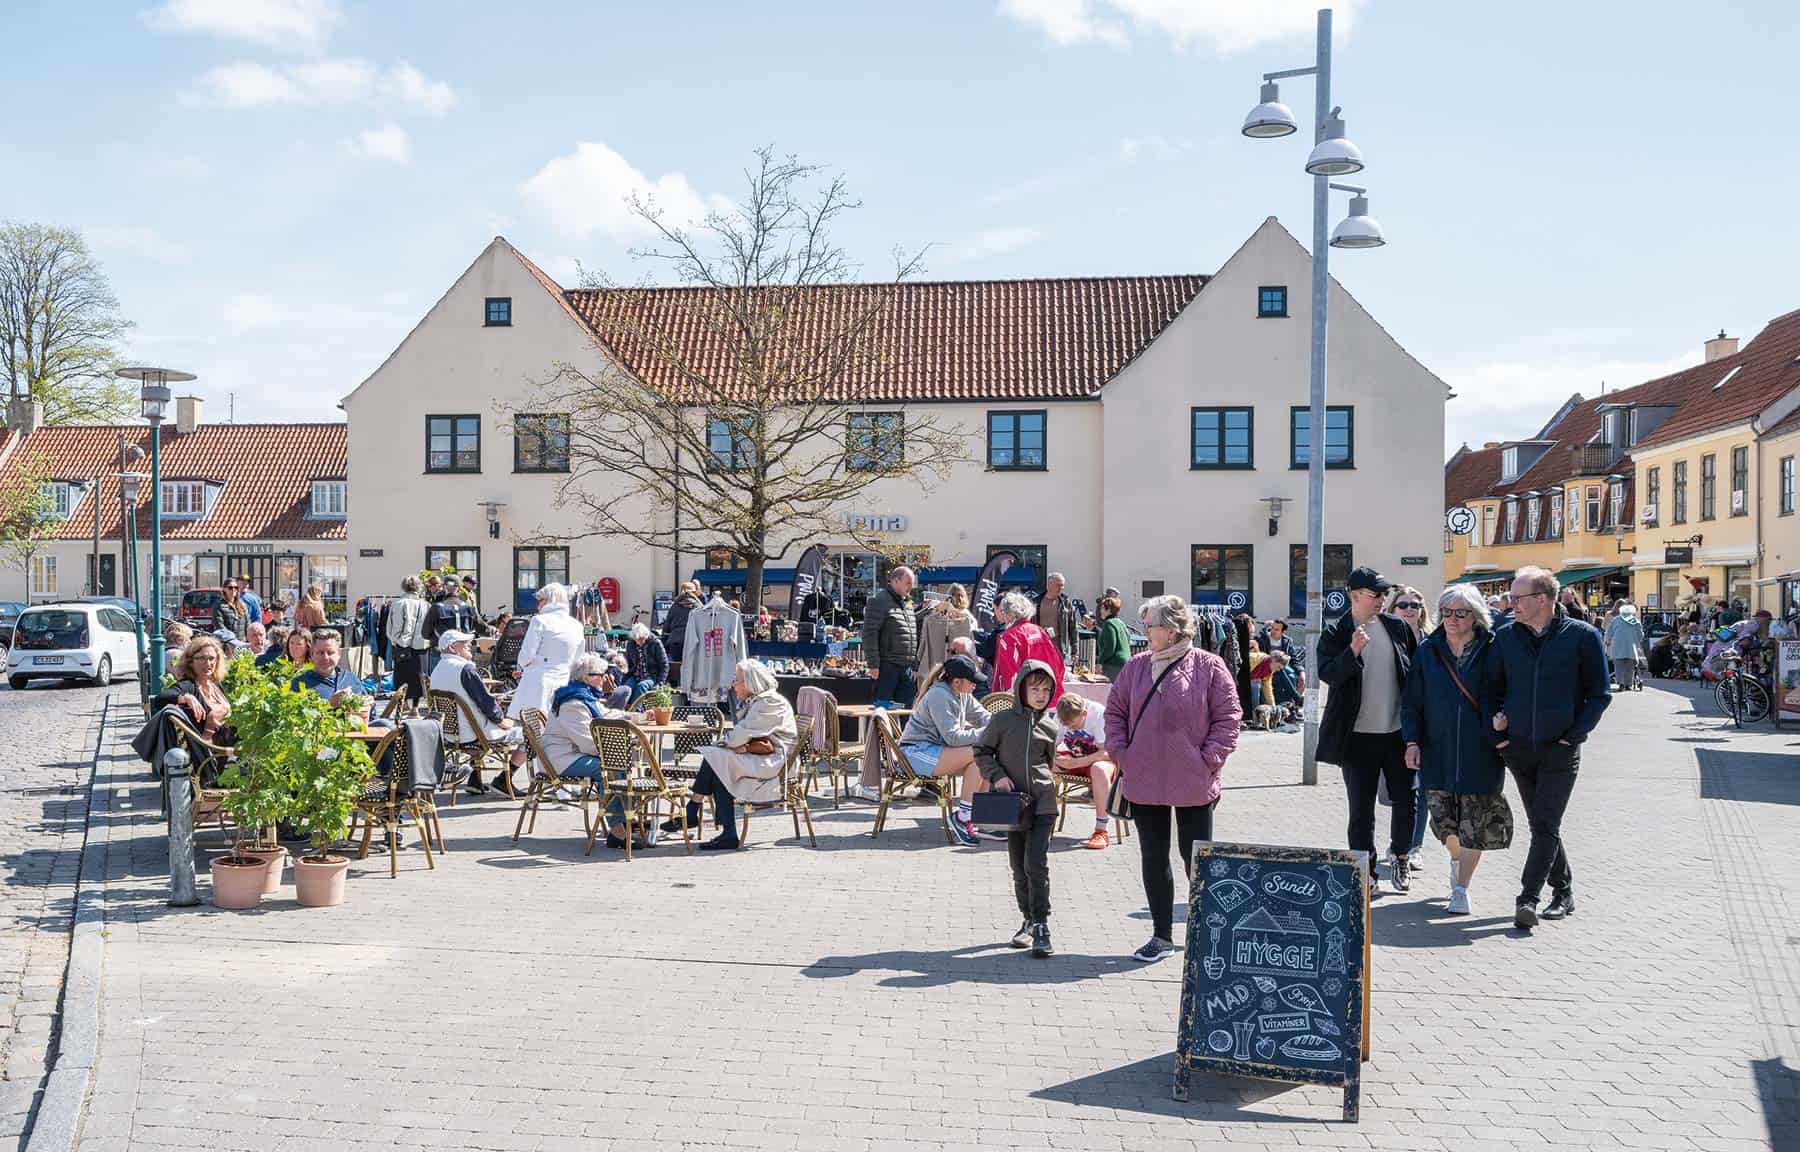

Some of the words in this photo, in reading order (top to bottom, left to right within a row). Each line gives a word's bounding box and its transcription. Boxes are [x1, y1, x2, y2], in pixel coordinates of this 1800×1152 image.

[1264, 875, 1316, 897] Sundt
[1236, 941, 1315, 970] HYGGE
[1206, 984, 1249, 1019] MAD
